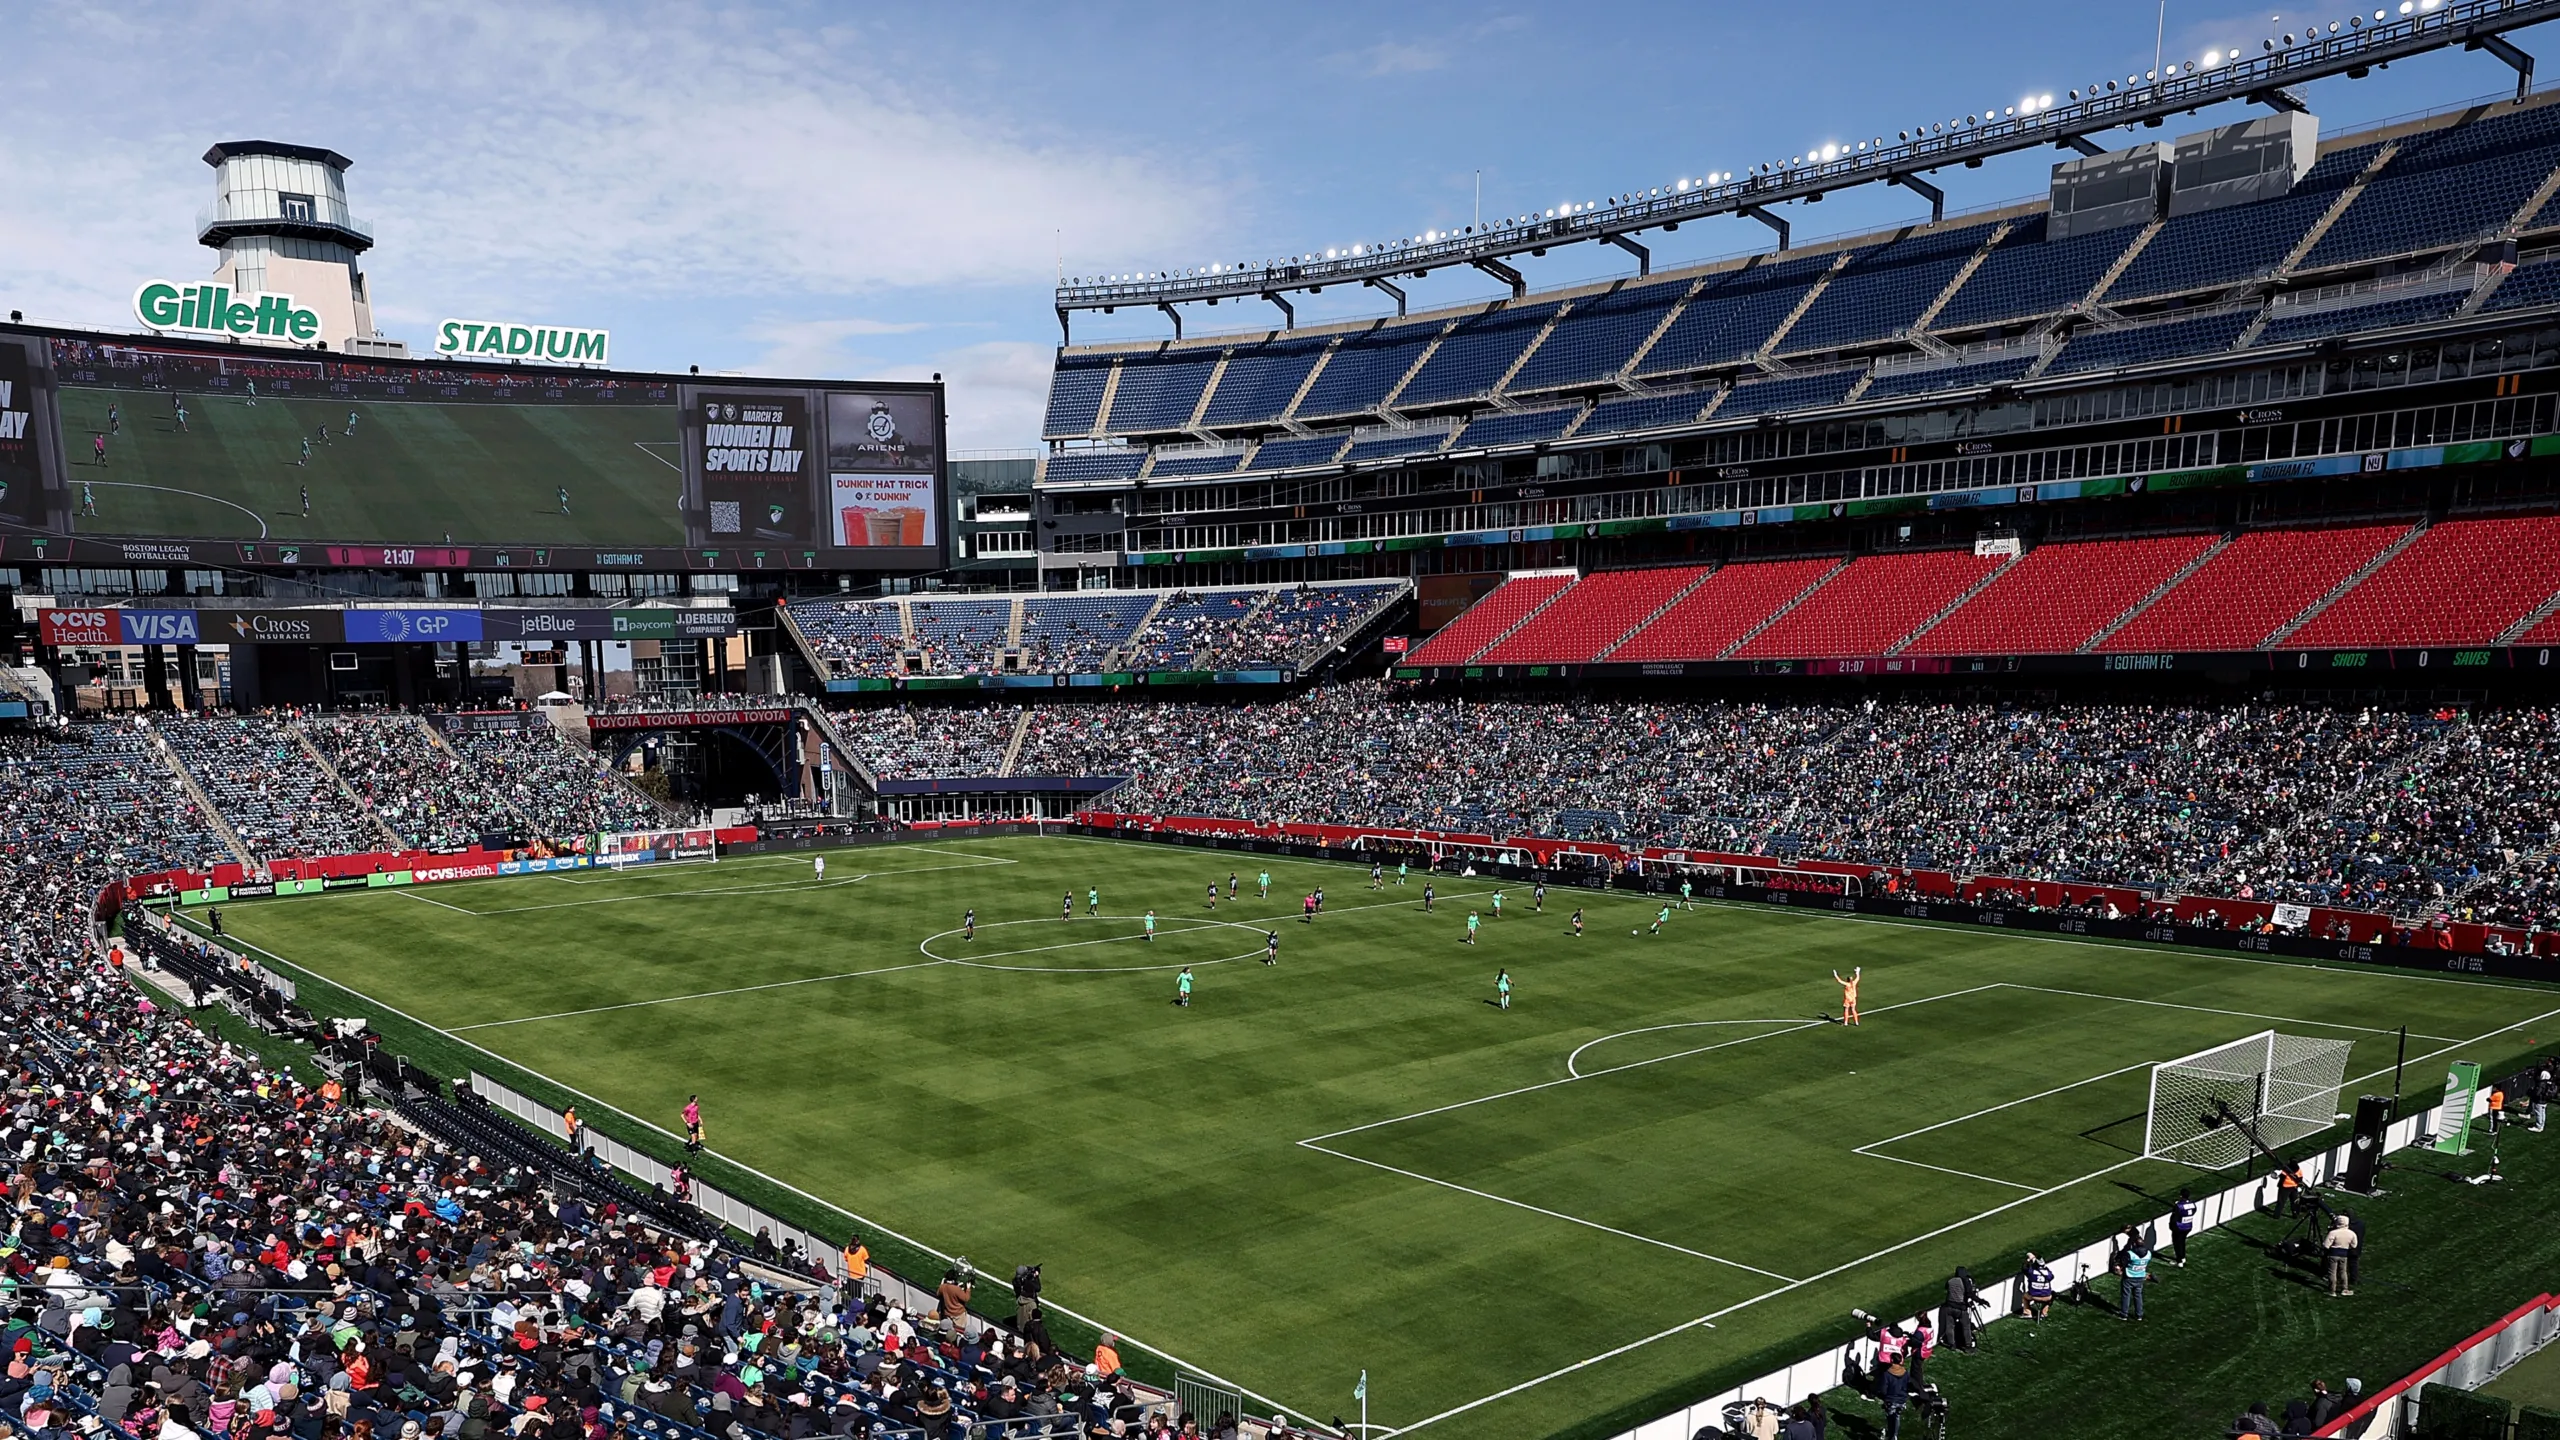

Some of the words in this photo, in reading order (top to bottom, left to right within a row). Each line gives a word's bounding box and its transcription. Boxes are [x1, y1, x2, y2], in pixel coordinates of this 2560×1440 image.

[140, 284, 318, 339] Gillette
[440, 322, 606, 361] STADIUM
[0, 380, 12, 408] N
[742, 410, 772, 423] MARCH
[771, 411, 783, 423] 28
[0, 411, 29, 439] AY
[706, 424, 773, 447] WOMEN
[773, 426, 793, 448] IN
[706, 448, 769, 472] SPORTS
[769, 450, 804, 472] DAY
[2261, 463, 2301, 478] GOTHAM
[2302, 462, 2315, 474] FC
[837, 480, 874, 488] DUNKIN'
[876, 480, 896, 488] HAT
[899, 480, 928, 488] TRICK
[2169, 473, 2203, 486] BOSTON
[874, 493, 911, 501] DUNKIN'
[1939, 494, 1970, 506] GOTHAM
[1971, 493, 1981, 504] FC
[36, 546, 44, 559] 0
[122, 544, 157, 552] BOSTON
[159, 545, 190, 553] LEGACY
[124, 552, 167, 560] FOOTBALL
[168, 552, 190, 561] CLUB
[247, 551, 253, 561] 5
[383, 549, 415, 565] 21:07
[538, 556, 543, 564] 5
[603, 554, 633, 565] GOTHAM
[634, 554, 643, 565] FC
[708, 557, 714, 568] 0
[756, 557, 762, 568] 0
[806, 557, 812, 568] 0
[68, 612, 107, 627] CVS
[252, 615, 310, 632] CROSS
[521, 614, 576, 635] jetBlue
[675, 612, 735, 626] J.DERENZO
[122, 615, 197, 639] VISA
[629, 620, 671, 631] paycom
[686, 625, 726, 634] COMPANIES
[523, 651, 562, 664] 21:07
[2114, 655, 2158, 670] GOTHAM
[2160, 654, 2173, 669] FC
[2299, 653, 2307, 668] 0
[2332, 653, 2367, 667] SHOTS
[2419, 652, 2428, 667] 0
[2453, 652, 2490, 665] SAVES
[2539, 649, 2549, 665] 0
[1561, 665, 1566, 677] 0
[1838, 660, 1865, 672] 21:07
[1886, 661, 1903, 672] HALF
[1911, 659, 1916, 672] 1
[1433, 667, 1439, 678] 0
[1464, 667, 1483, 677] SAVES
[1497, 666, 1503, 678] 0
[594, 716, 641, 728] TOYOTA
[645, 714, 691, 726] TOYOTA
[695, 712, 739, 724] TOYOTA
[743, 710, 786, 722] TOYOTA
[487, 721, 499, 729] AIR
[501, 720, 521, 728] FORCE
[501, 862, 521, 870] prime
[528, 860, 548, 868] prime
[555, 857, 574, 866] prime
[1904, 904, 1917, 916] elf
[1978, 911, 1993, 923] elf
[2059, 919, 2074, 932] elf
[2145, 928, 2162, 940] elf
[2238, 937, 2258, 950] elf
[2339, 945, 2359, 959] elf
[2447, 955, 2469, 970] elf
